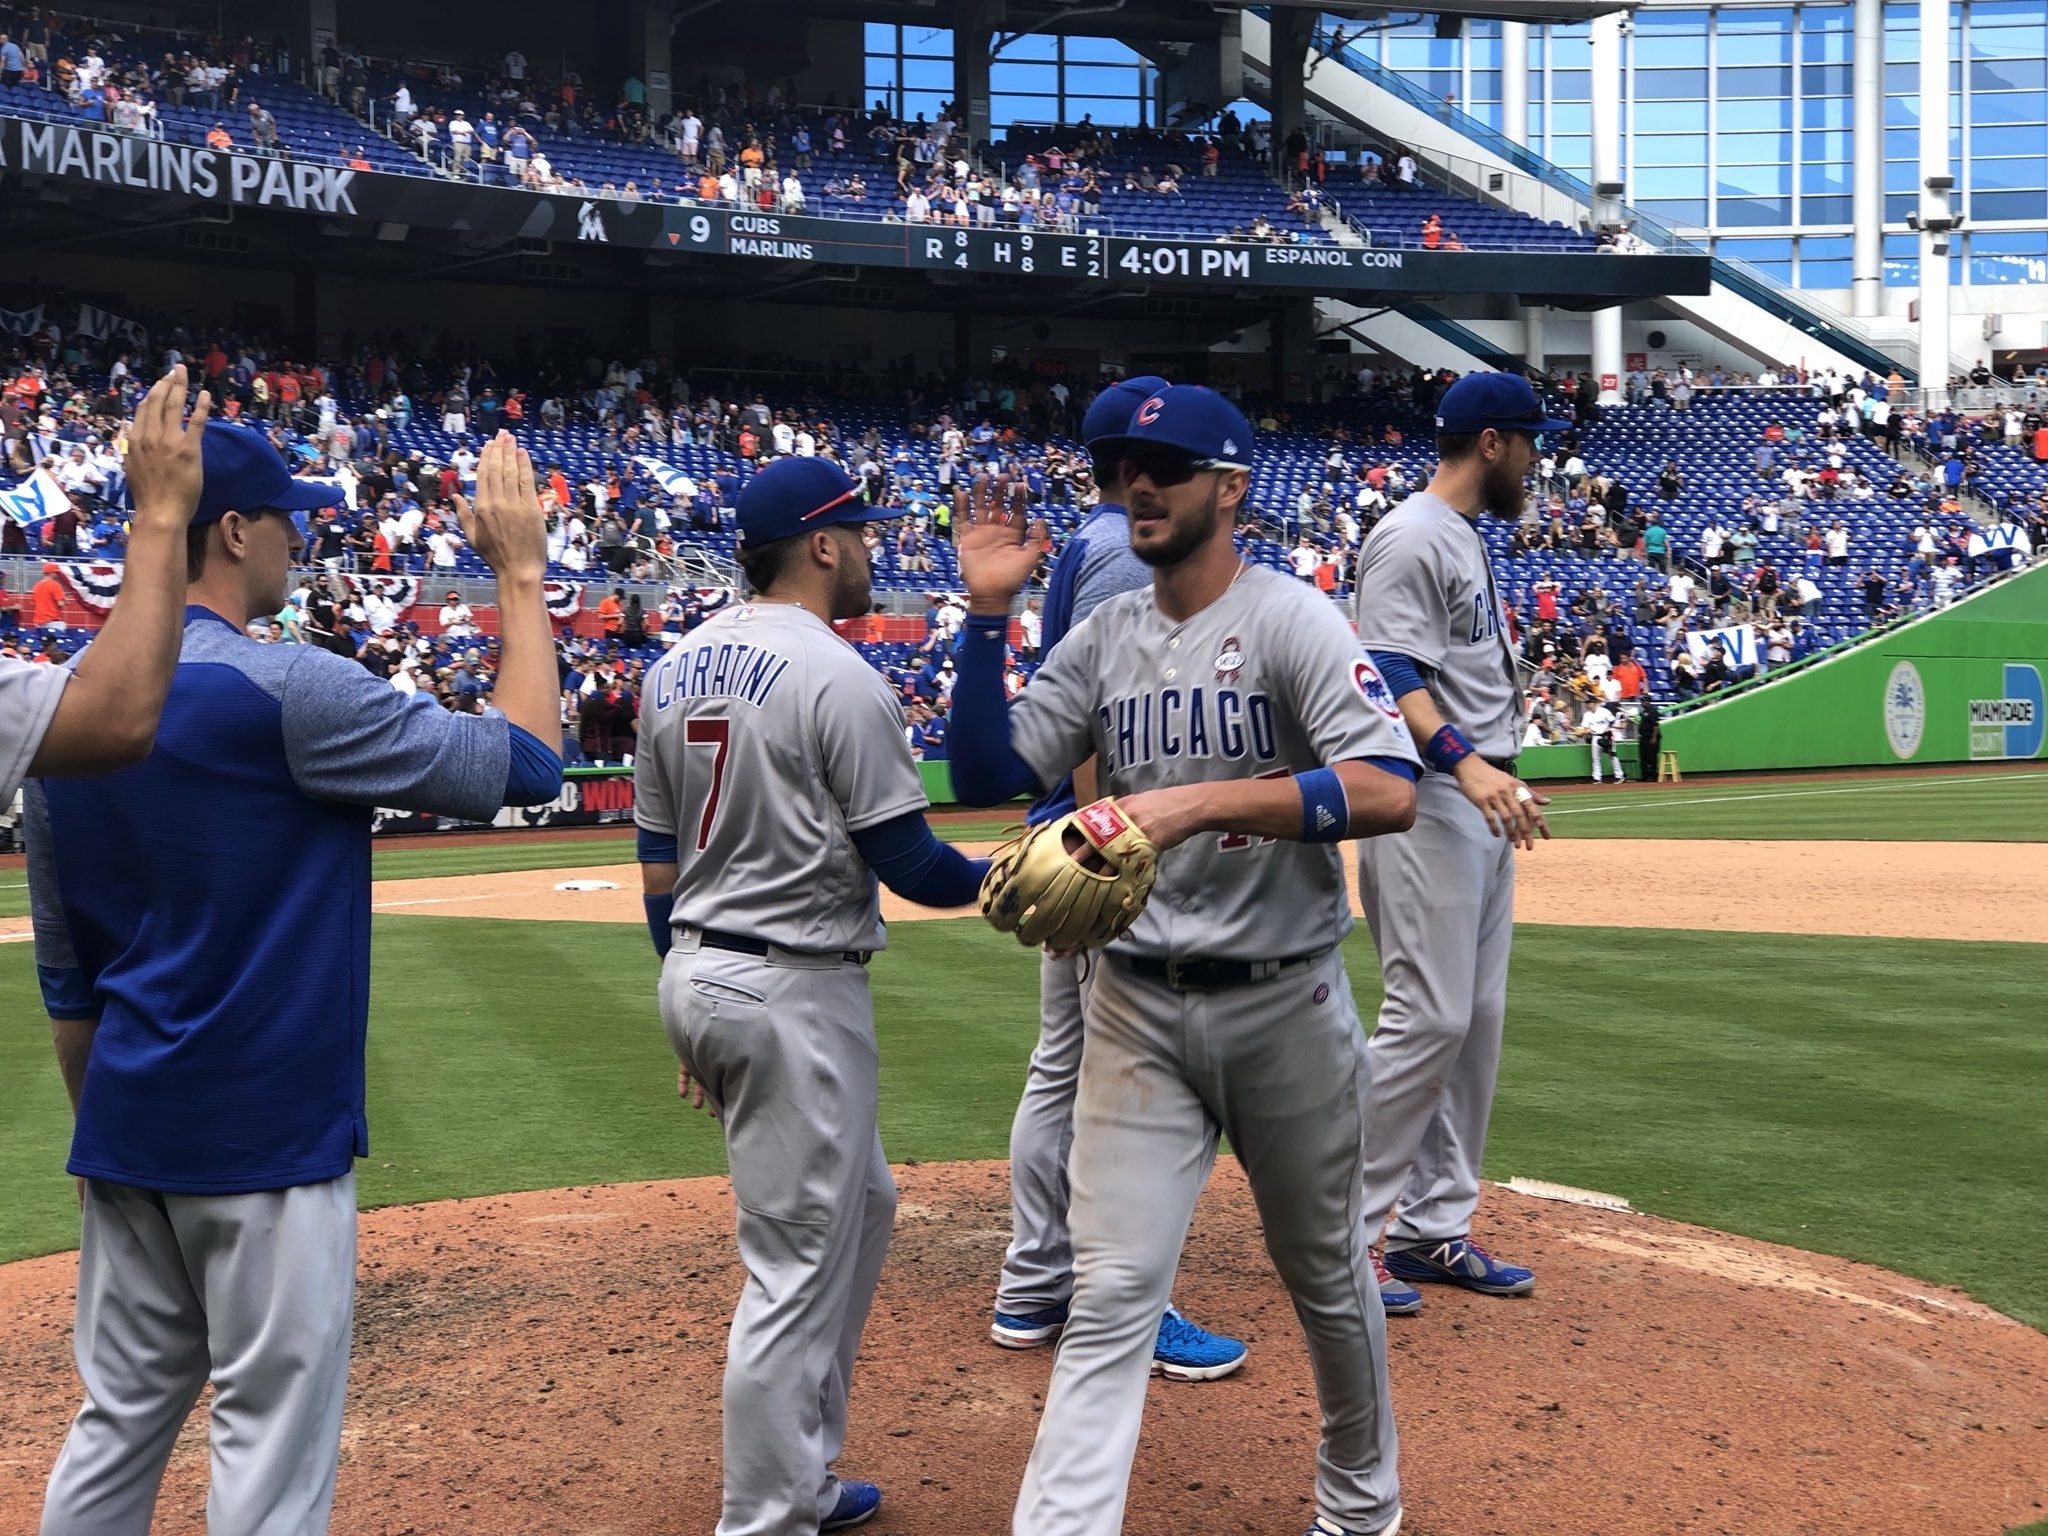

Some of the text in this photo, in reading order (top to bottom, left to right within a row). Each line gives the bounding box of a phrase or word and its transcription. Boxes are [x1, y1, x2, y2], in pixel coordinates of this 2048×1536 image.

[21, 122, 219, 199] MARLINS
[231, 155, 359, 216] PARK
[689, 215, 711, 243] 9
[730, 215, 781, 236] CUBS
[730, 237, 813, 260] MARLINS
[925, 238, 944, 259] R
[955, 231, 969, 247] 8
[1020, 235, 1034, 251] 9
[1087, 239, 1100, 255] 2
[954, 252, 969, 269] 4
[993, 242, 1012, 263] H
[1061, 246, 1077, 267] E
[1119, 246, 1250, 278] 4:01 PM
[1265, 248, 1403, 269] ESPANOL CON
[1021, 256, 1035, 272] 8
[1087, 261, 1100, 277] 2
[1136, 398, 1165, 426] C
[655, 643, 793, 713] CARATINI
[1970, 702, 2032, 721] MIAMI-DADE
[1099, 685, 1280, 778] CHICAGO
[684, 716, 730, 853] 7
